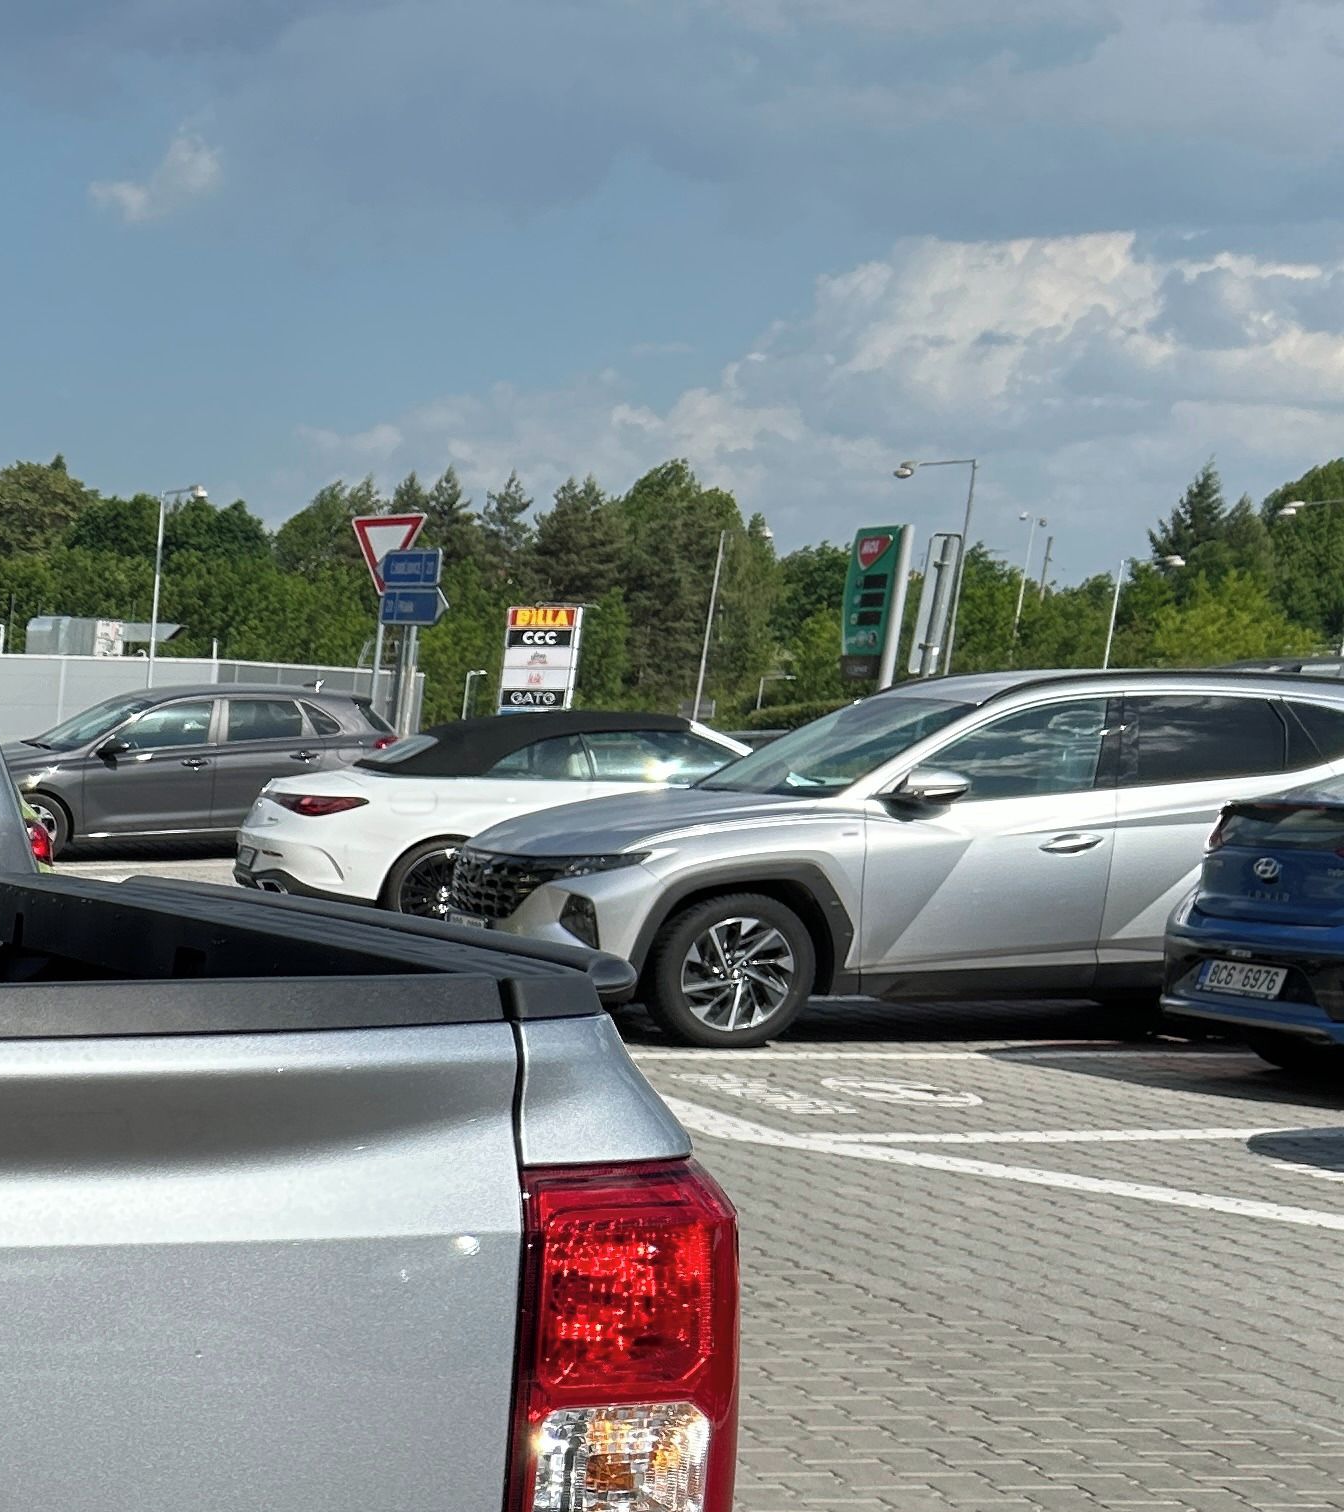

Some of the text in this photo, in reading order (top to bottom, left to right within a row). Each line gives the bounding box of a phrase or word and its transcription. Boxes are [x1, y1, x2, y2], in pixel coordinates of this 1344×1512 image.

[516, 608, 569, 626] BILLA
[522, 631, 557, 645] CCC
[1241, 968, 1280, 992] 6976
